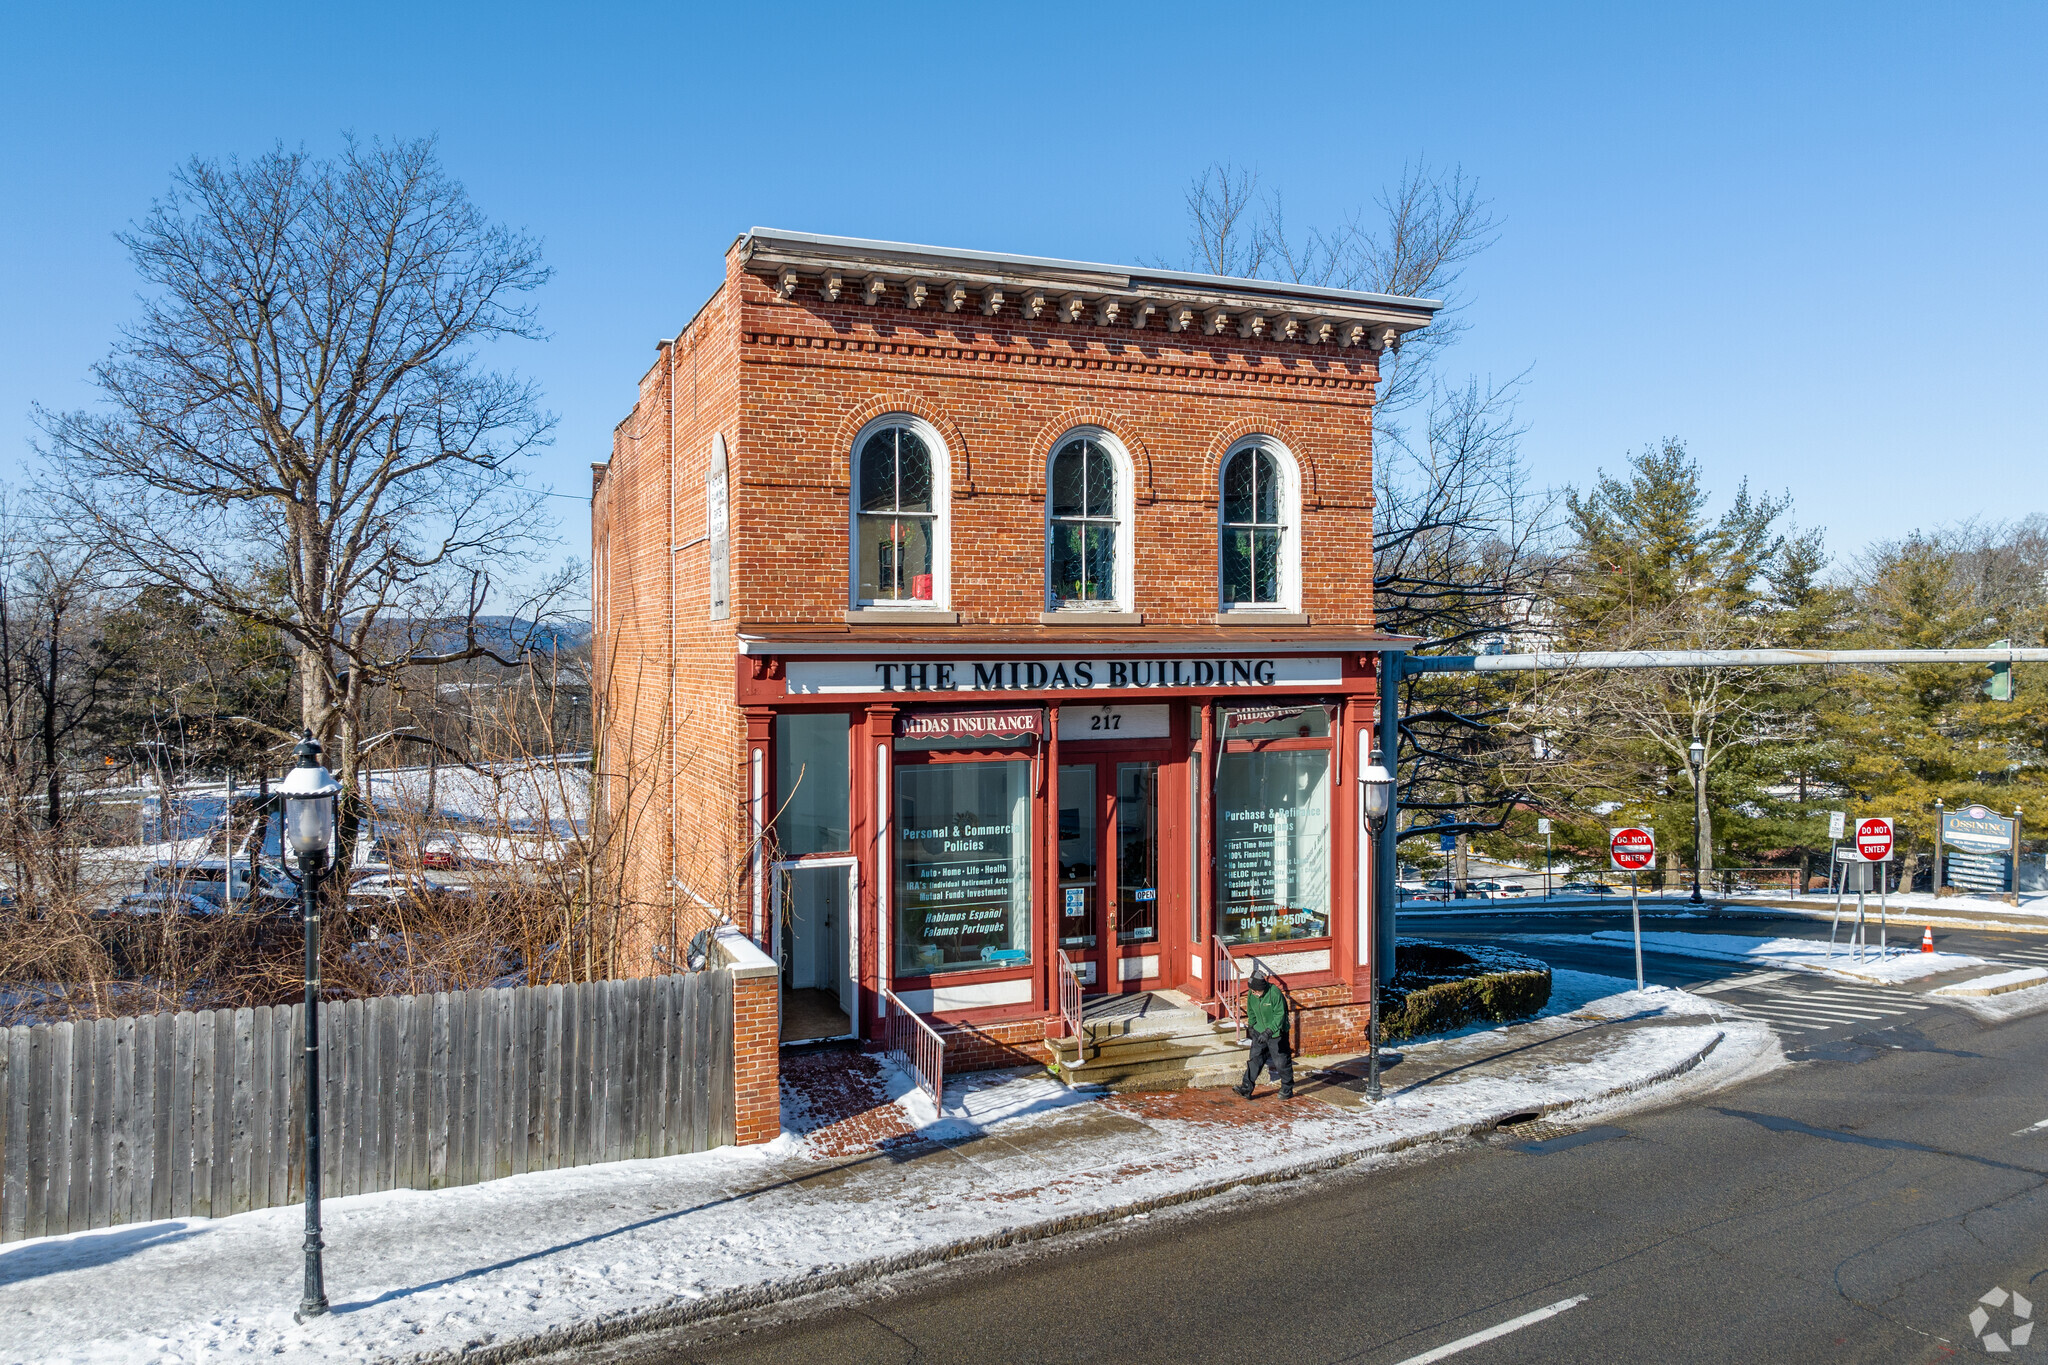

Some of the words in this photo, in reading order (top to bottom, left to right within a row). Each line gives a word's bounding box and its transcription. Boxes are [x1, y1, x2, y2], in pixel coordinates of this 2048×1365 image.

[875, 663, 956, 692] THE
[972, 661, 1093, 691] MIDAS
[1107, 660, 1275, 688] BUILDING
[902, 718, 950, 734] MIDAS
[953, 715, 1034, 732] INSURANCE
[1091, 715, 1122, 730] 217
[1225, 809, 1265, 821] Purchase
[1269, 808, 1277, 819] &
[1279, 807, 1321, 818] Refinance
[1253, 822, 1294, 834] Programs
[1874, 826, 1888, 834] NOT
[1950, 818, 2006, 832] OSSINING
[903, 826, 948, 840] Personal
[953, 825, 960, 837] &
[944, 840, 984, 852] Policies
[1228, 842, 1242, 850] First
[1243, 841, 1257, 849] Time
[1864, 846, 1886, 854] ENTER
[1228, 852, 1242, 860] 100%
[1243, 850, 1270, 859] Financing
[1620, 854, 1645, 862] ENTER
[1228, 861, 1236, 869] No
[1237, 860, 1258, 869] Income
[1264, 859, 1271, 867] No
[921, 869, 937, 878] Auto
[942, 867, 961, 877] Home
[967, 866, 980, 875] Life
[985, 864, 1007, 874] Health
[1228, 870, 1249, 879] HELOC
[1251, 869, 1267, 878] (Home
[906, 881, 926, 890] IRA's
[961, 877, 994, 887] Retirement
[920, 892, 943, 901] Mutual
[945, 890, 965, 900] Funds
[967, 887, 1008, 898] Investments
[1138, 890, 1154, 899] OPEN
[1231, 889, 1249, 898] Mixed
[925, 911, 966, 923] Hablamos
[969, 908, 1003, 921] Español
[1226, 906, 1249, 915] Making
[1240, 913, 1307, 930] 914-941-2500
[923, 926, 959, 938] Falamos
